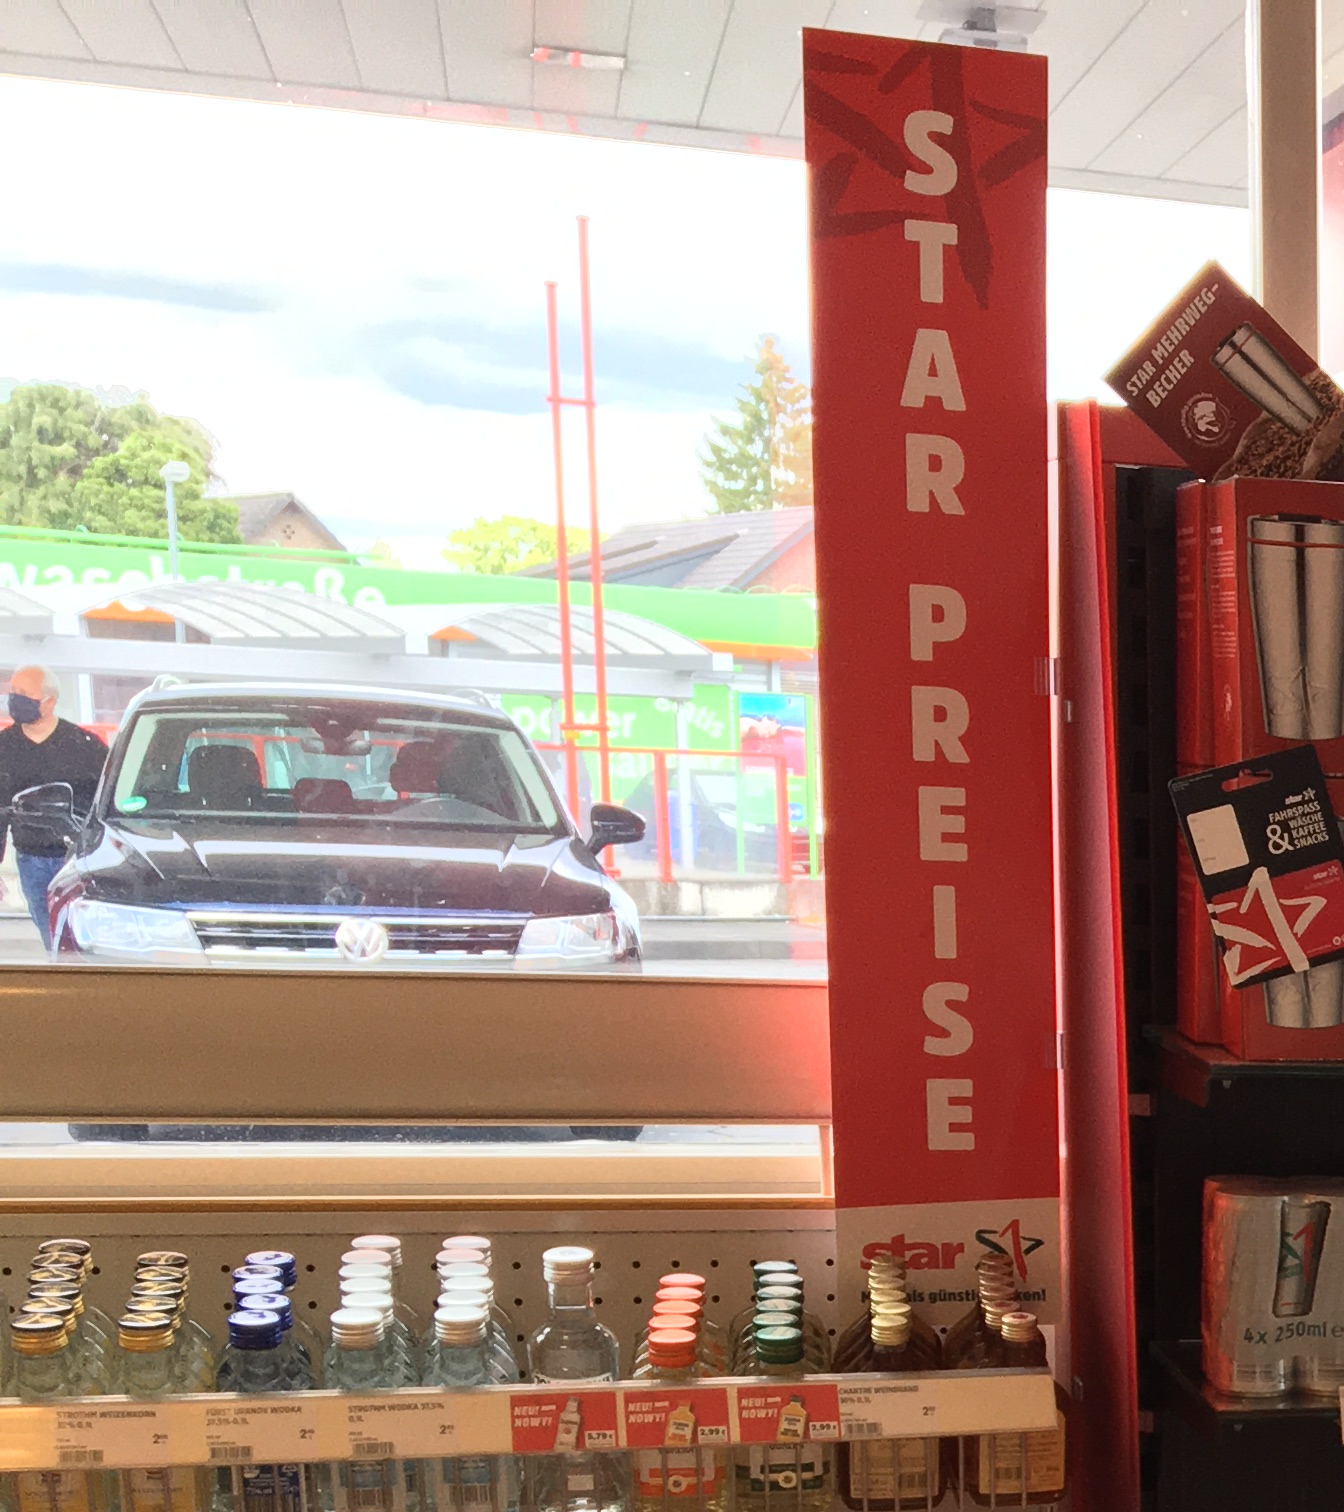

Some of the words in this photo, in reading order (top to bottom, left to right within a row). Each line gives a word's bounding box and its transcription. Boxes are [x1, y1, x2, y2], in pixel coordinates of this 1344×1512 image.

[901, 110, 966, 515] STAR
[1126, 361, 1156, 397] STAR
[1151, 283, 1219, 365] MEHRWEG-
[1145, 350, 1195, 408] BECHER
[1268, 801, 1321, 824] FAHRSPASS
[1266, 825, 1295, 855] &
[908, 583, 976, 1152] PREISE
[929, 1287, 980, 1306] günsti
[1275, 1320, 1327, 1343] 250ml
